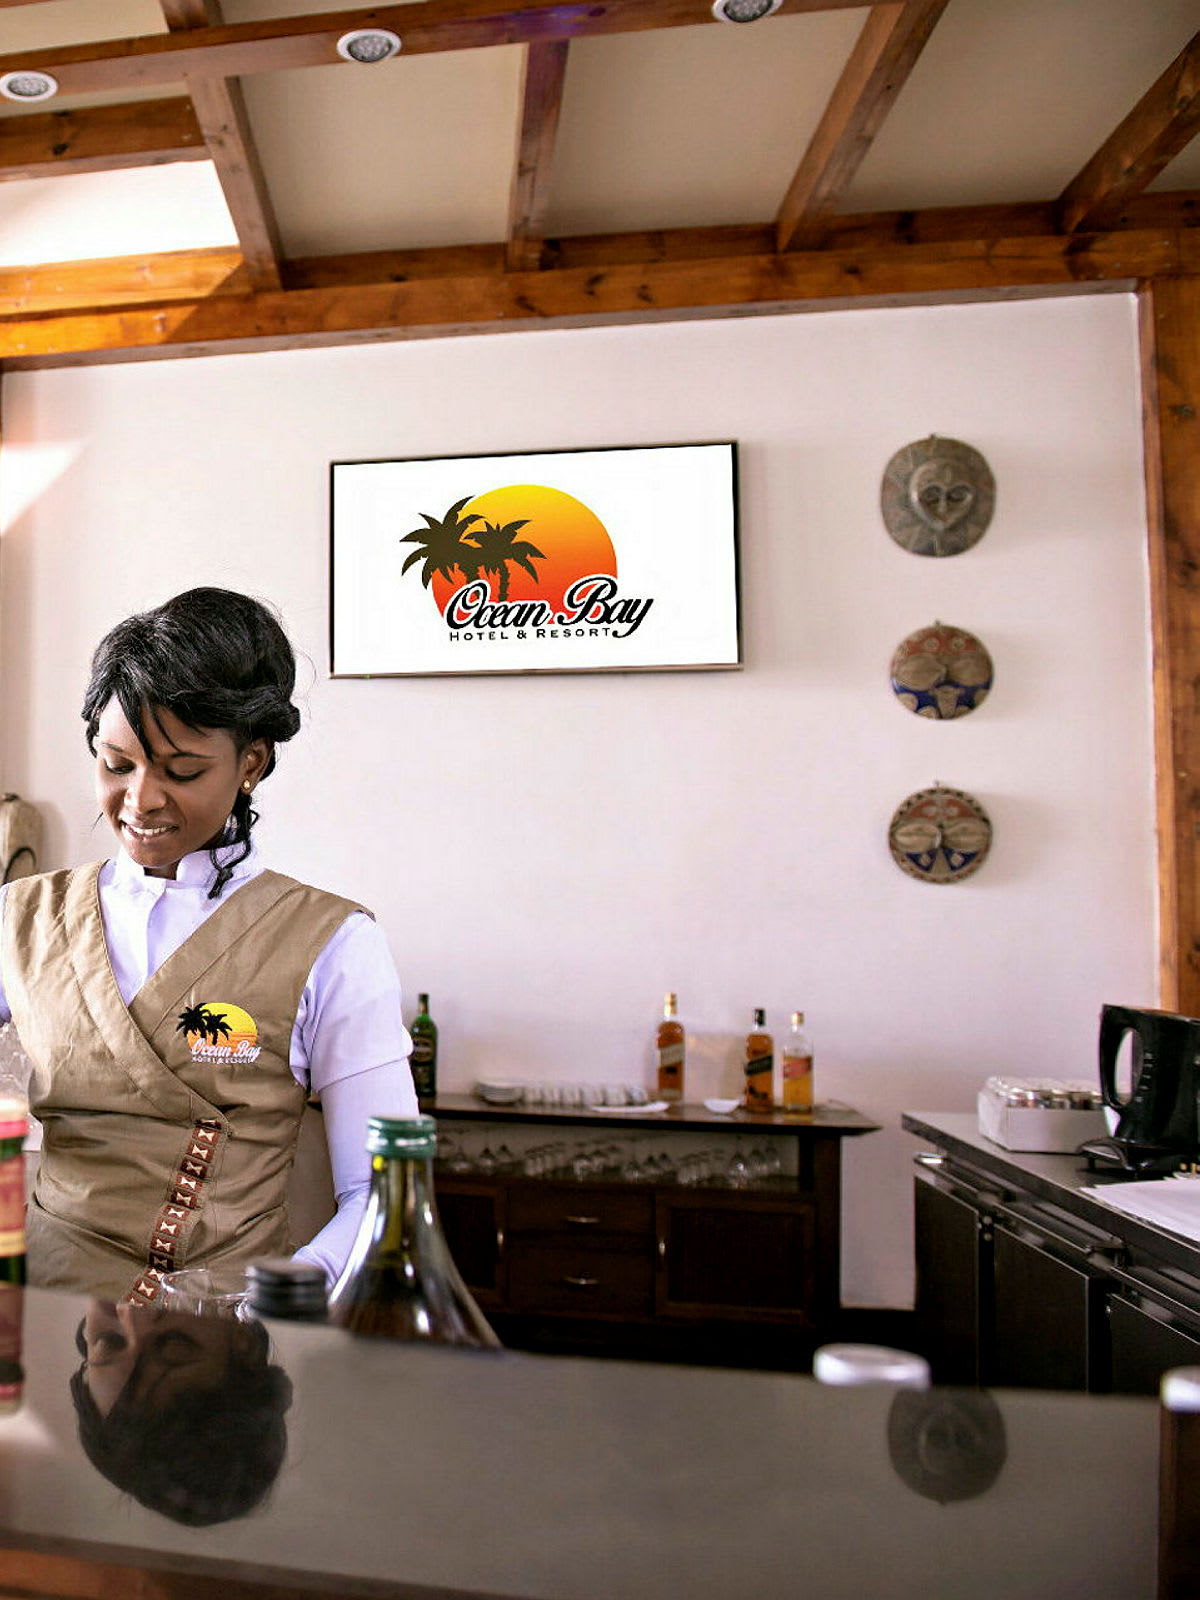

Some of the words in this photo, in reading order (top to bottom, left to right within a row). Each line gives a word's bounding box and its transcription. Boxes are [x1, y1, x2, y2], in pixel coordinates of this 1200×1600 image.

[446, 582, 550, 630] Ocean
[557, 576, 654, 638] Bay
[449, 631, 508, 642] HOTEL
[517, 630, 527, 640] &
[536, 628, 610, 640] RESORT
